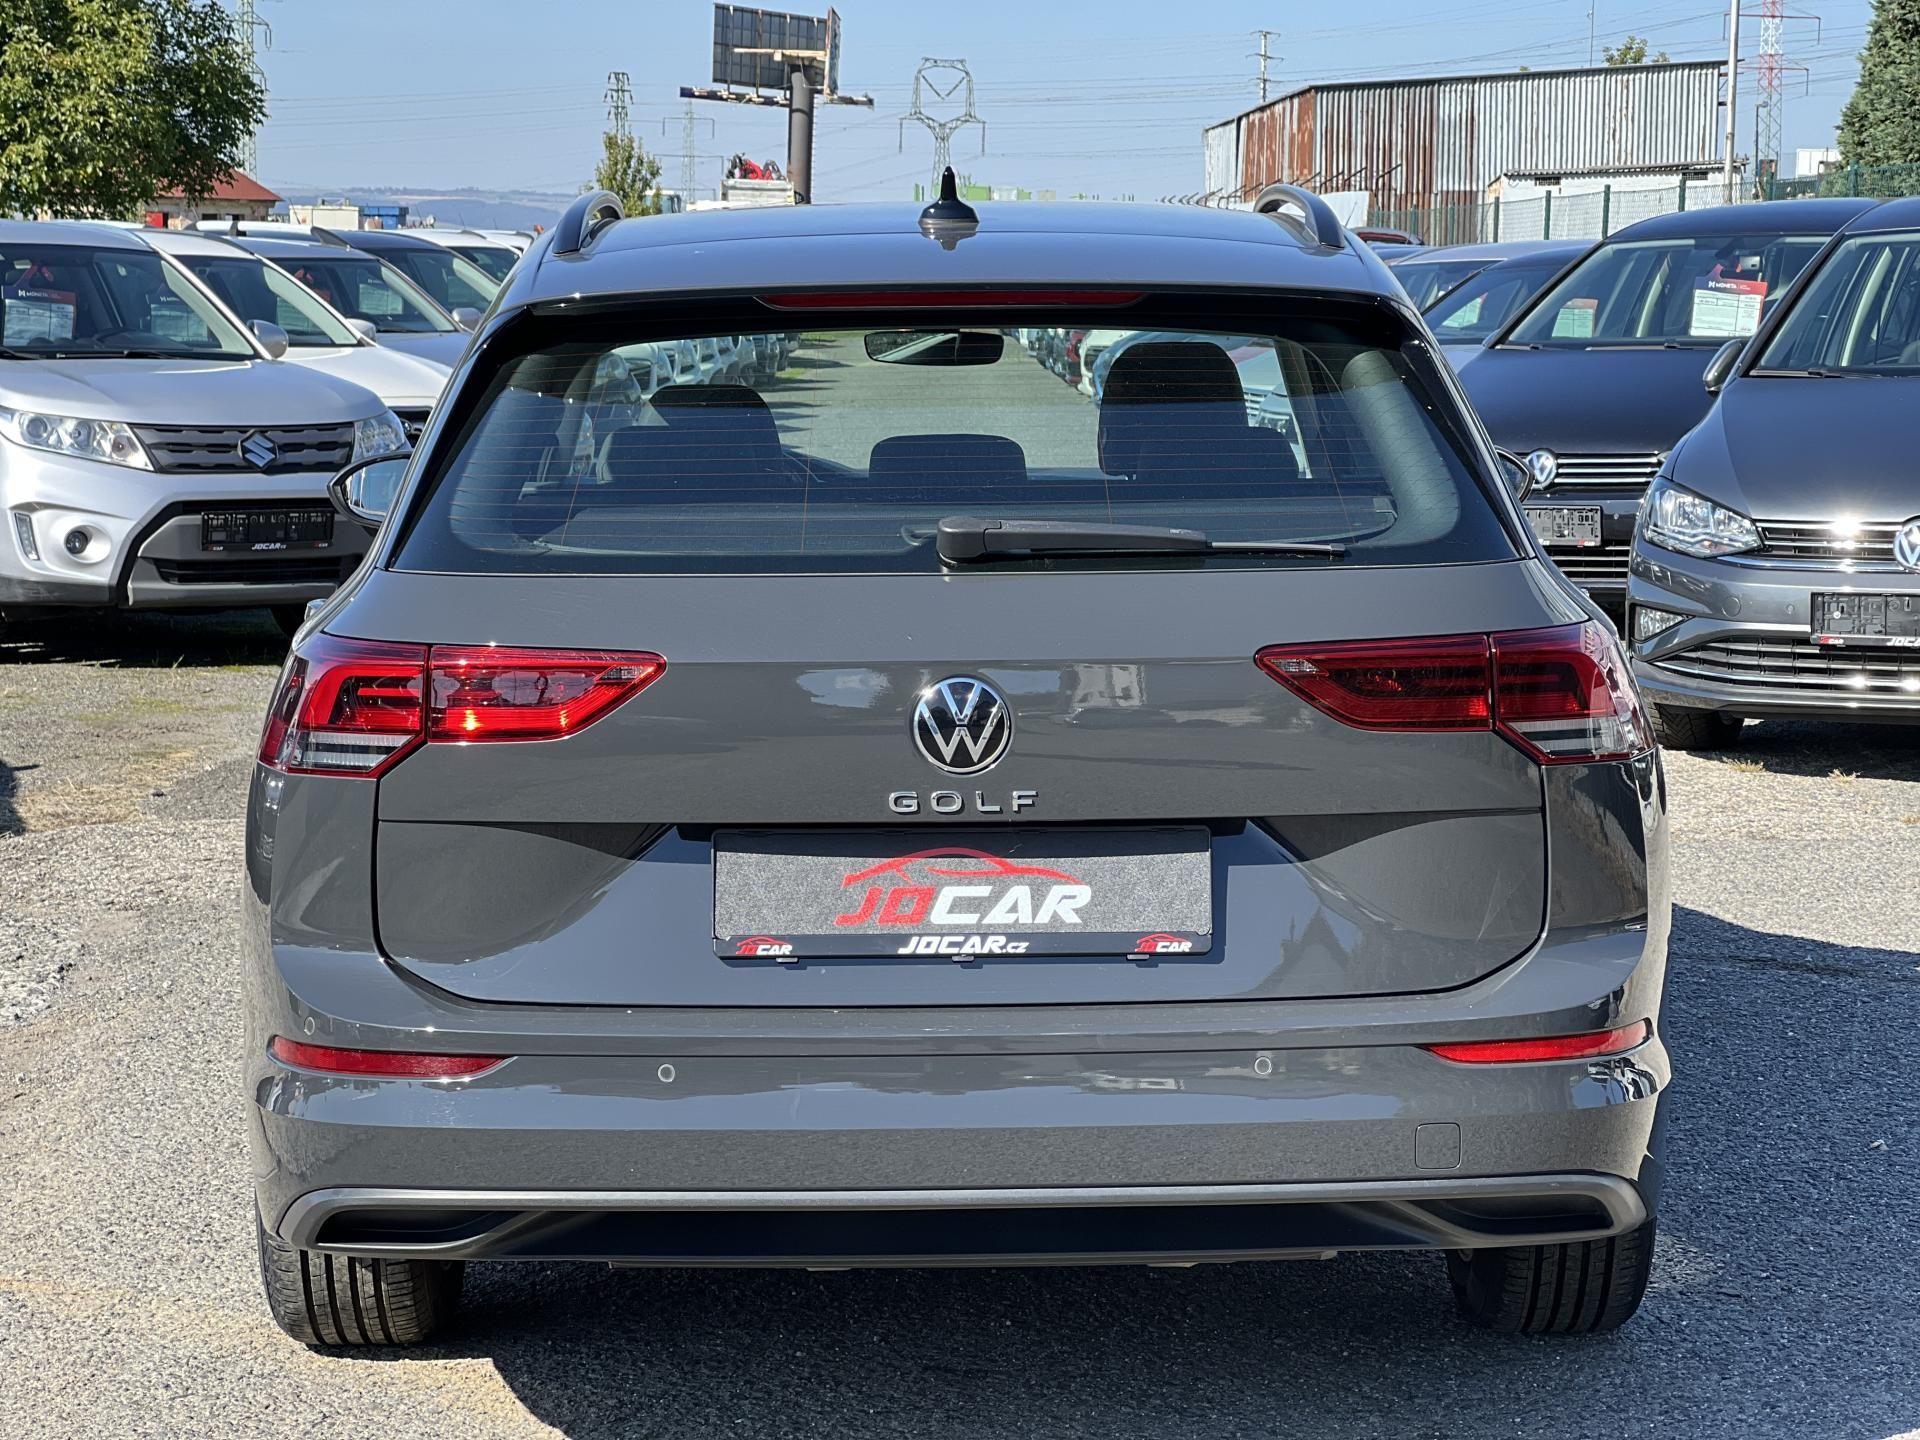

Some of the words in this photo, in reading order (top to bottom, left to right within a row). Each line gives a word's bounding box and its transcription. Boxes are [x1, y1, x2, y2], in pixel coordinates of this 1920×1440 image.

[888, 791, 1039, 813] GOLF
[833, 885, 1092, 926] JOCAR
[897, 935, 1030, 954] JOCAR.cz
